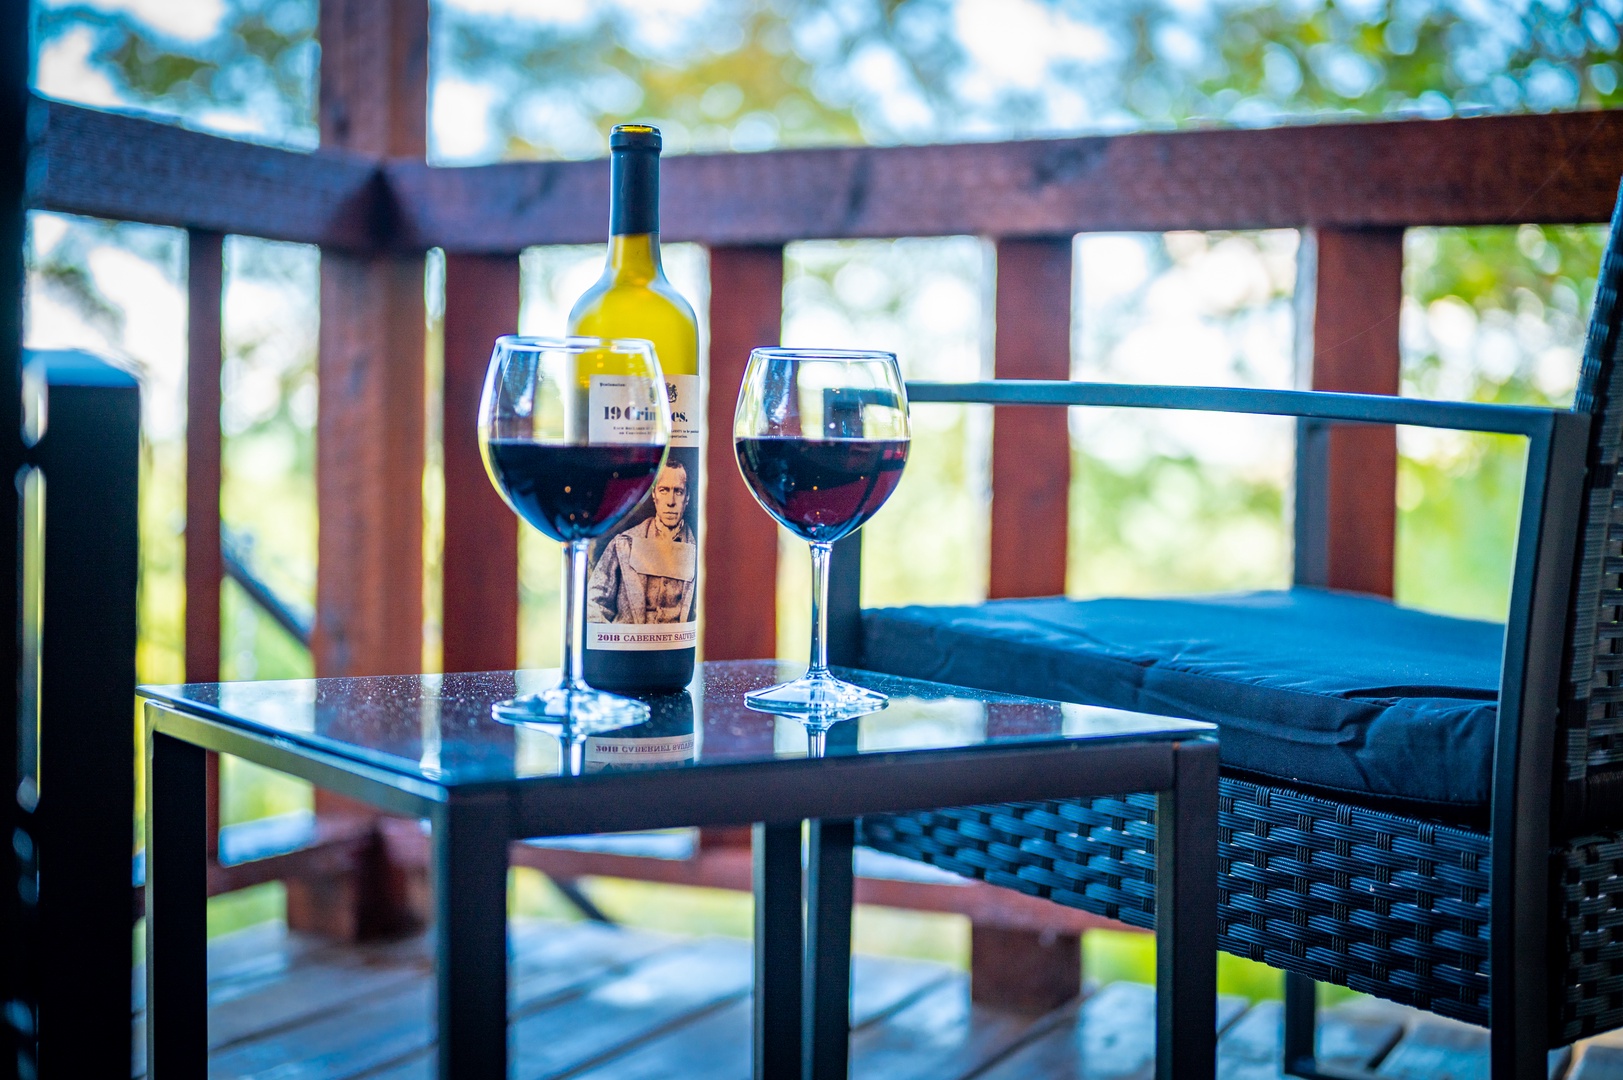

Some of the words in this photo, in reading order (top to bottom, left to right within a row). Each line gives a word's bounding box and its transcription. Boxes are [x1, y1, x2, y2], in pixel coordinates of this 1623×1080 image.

[604, 406, 621, 420] 19
[624, 406, 688, 423] Cries.
[624, 634, 673, 642] CABERNET
